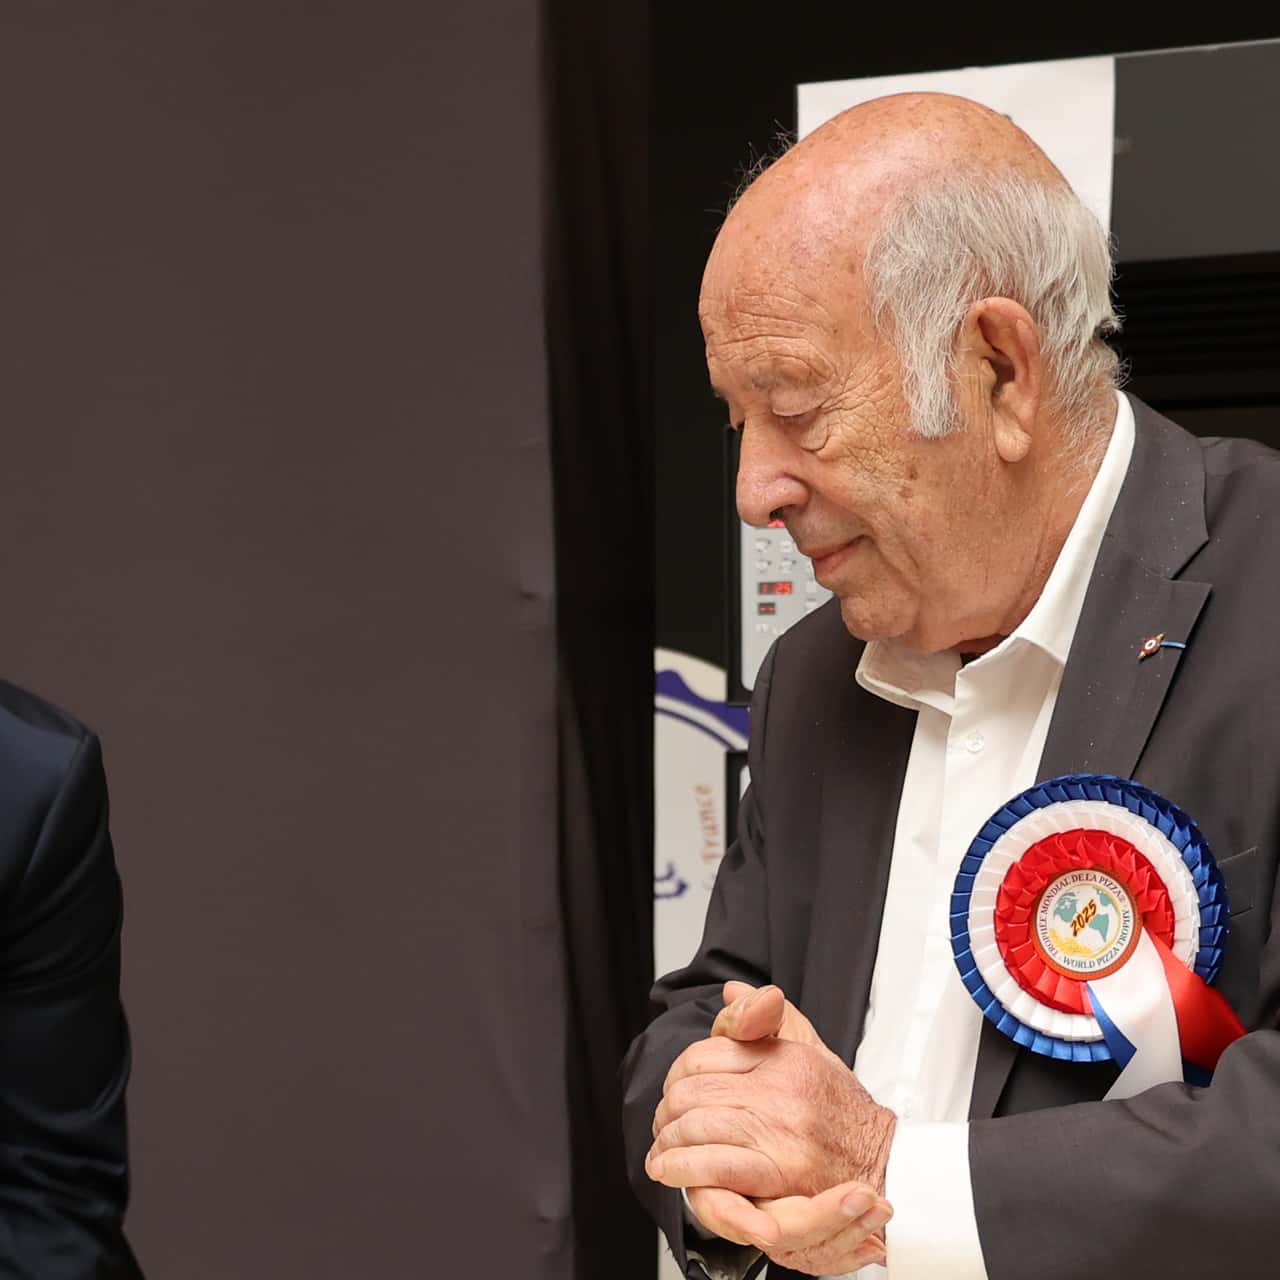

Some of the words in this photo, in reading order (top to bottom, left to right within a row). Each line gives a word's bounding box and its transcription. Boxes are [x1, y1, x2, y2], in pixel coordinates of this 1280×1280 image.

[1041, 878, 1071, 914] MONDIAL
[1071, 873, 1084, 883] DE
[1085, 873, 1097, 883] LA
[1070, 898, 1098, 938] 2025
[1063, 955, 1096, 969] WORLD
[1096, 947, 1120, 966] PIZZA
